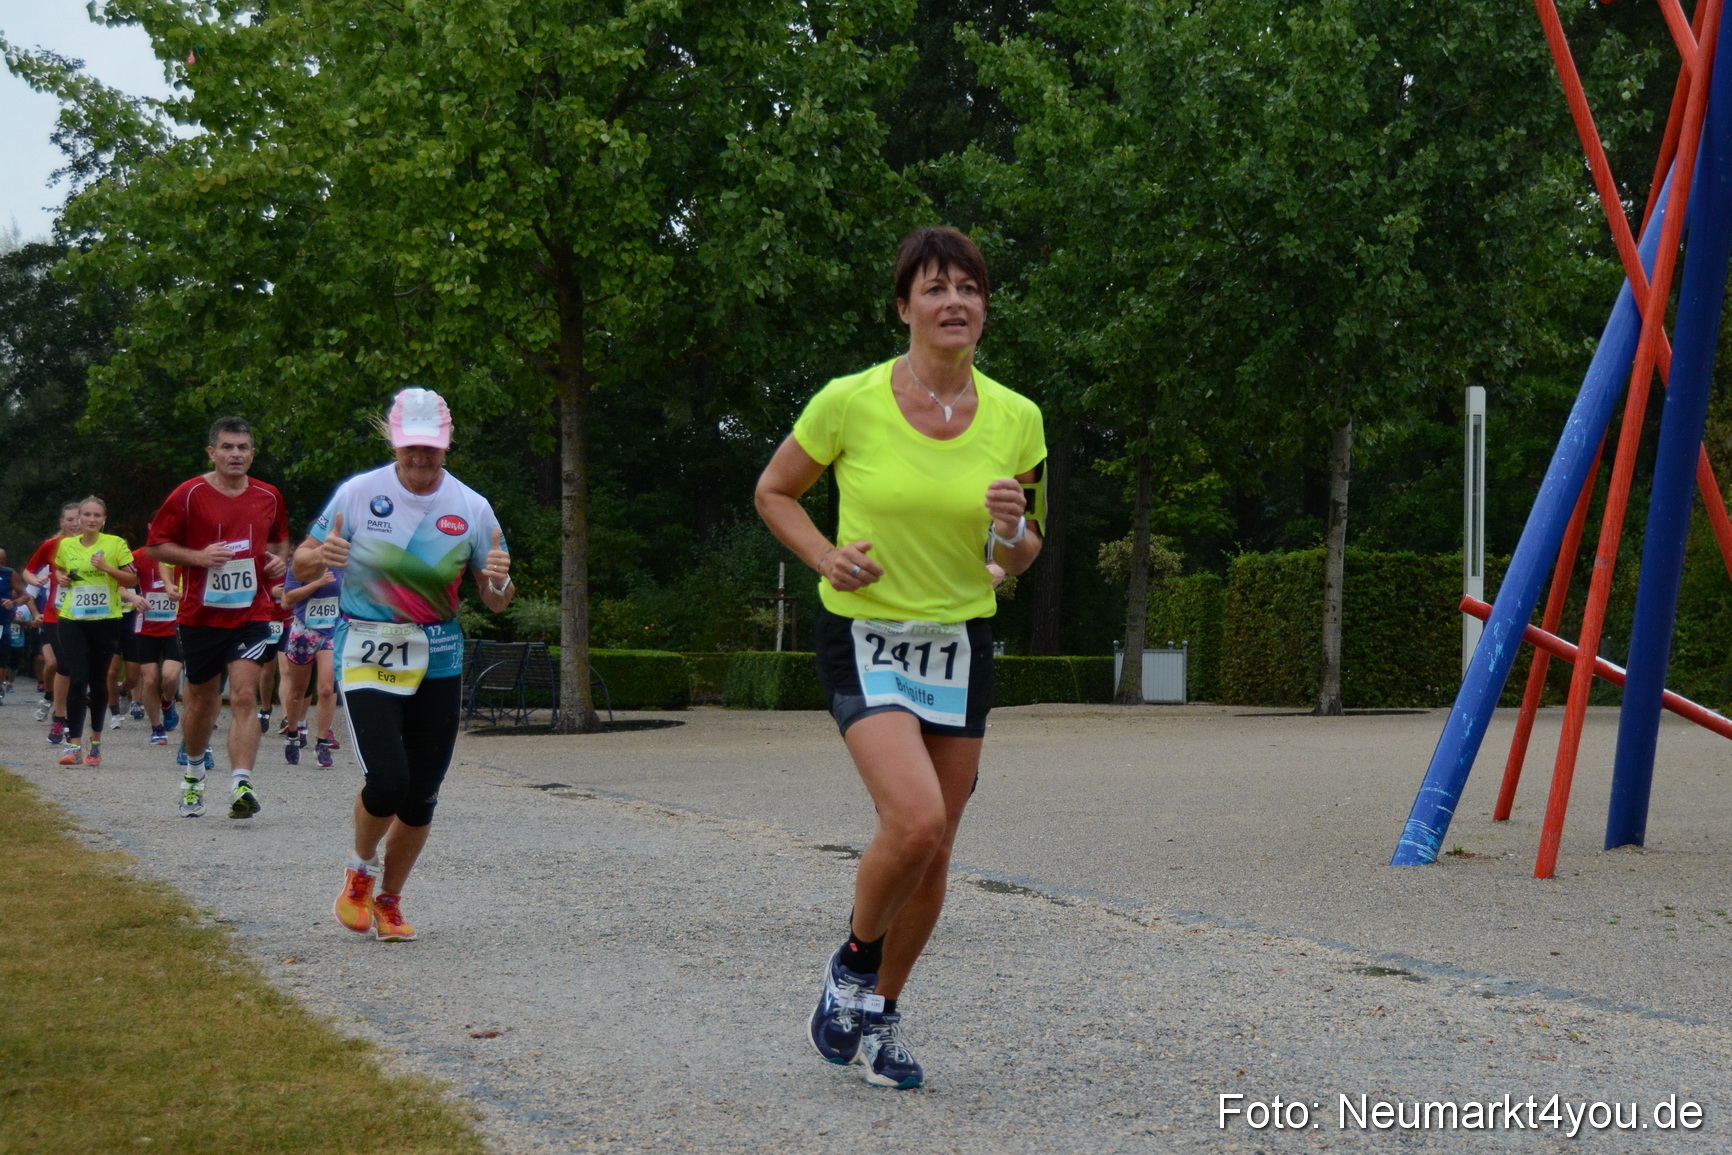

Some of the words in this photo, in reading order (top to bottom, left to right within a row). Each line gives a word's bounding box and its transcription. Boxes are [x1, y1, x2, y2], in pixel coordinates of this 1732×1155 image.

[367, 519, 393, 530] PARTL
[441, 519, 465, 531] Hervis
[212, 571, 252, 591] 3076
[76, 592, 107, 607] 2892
[309, 604, 336, 617] 2469
[427, 626, 446, 637] 17.
[361, 640, 409, 668] 221
[429, 642, 457, 653] Stadtlauf
[865, 633, 958, 680] 2411
[377, 671, 396, 683] Eva
[895, 676, 935, 705] Brigitte
